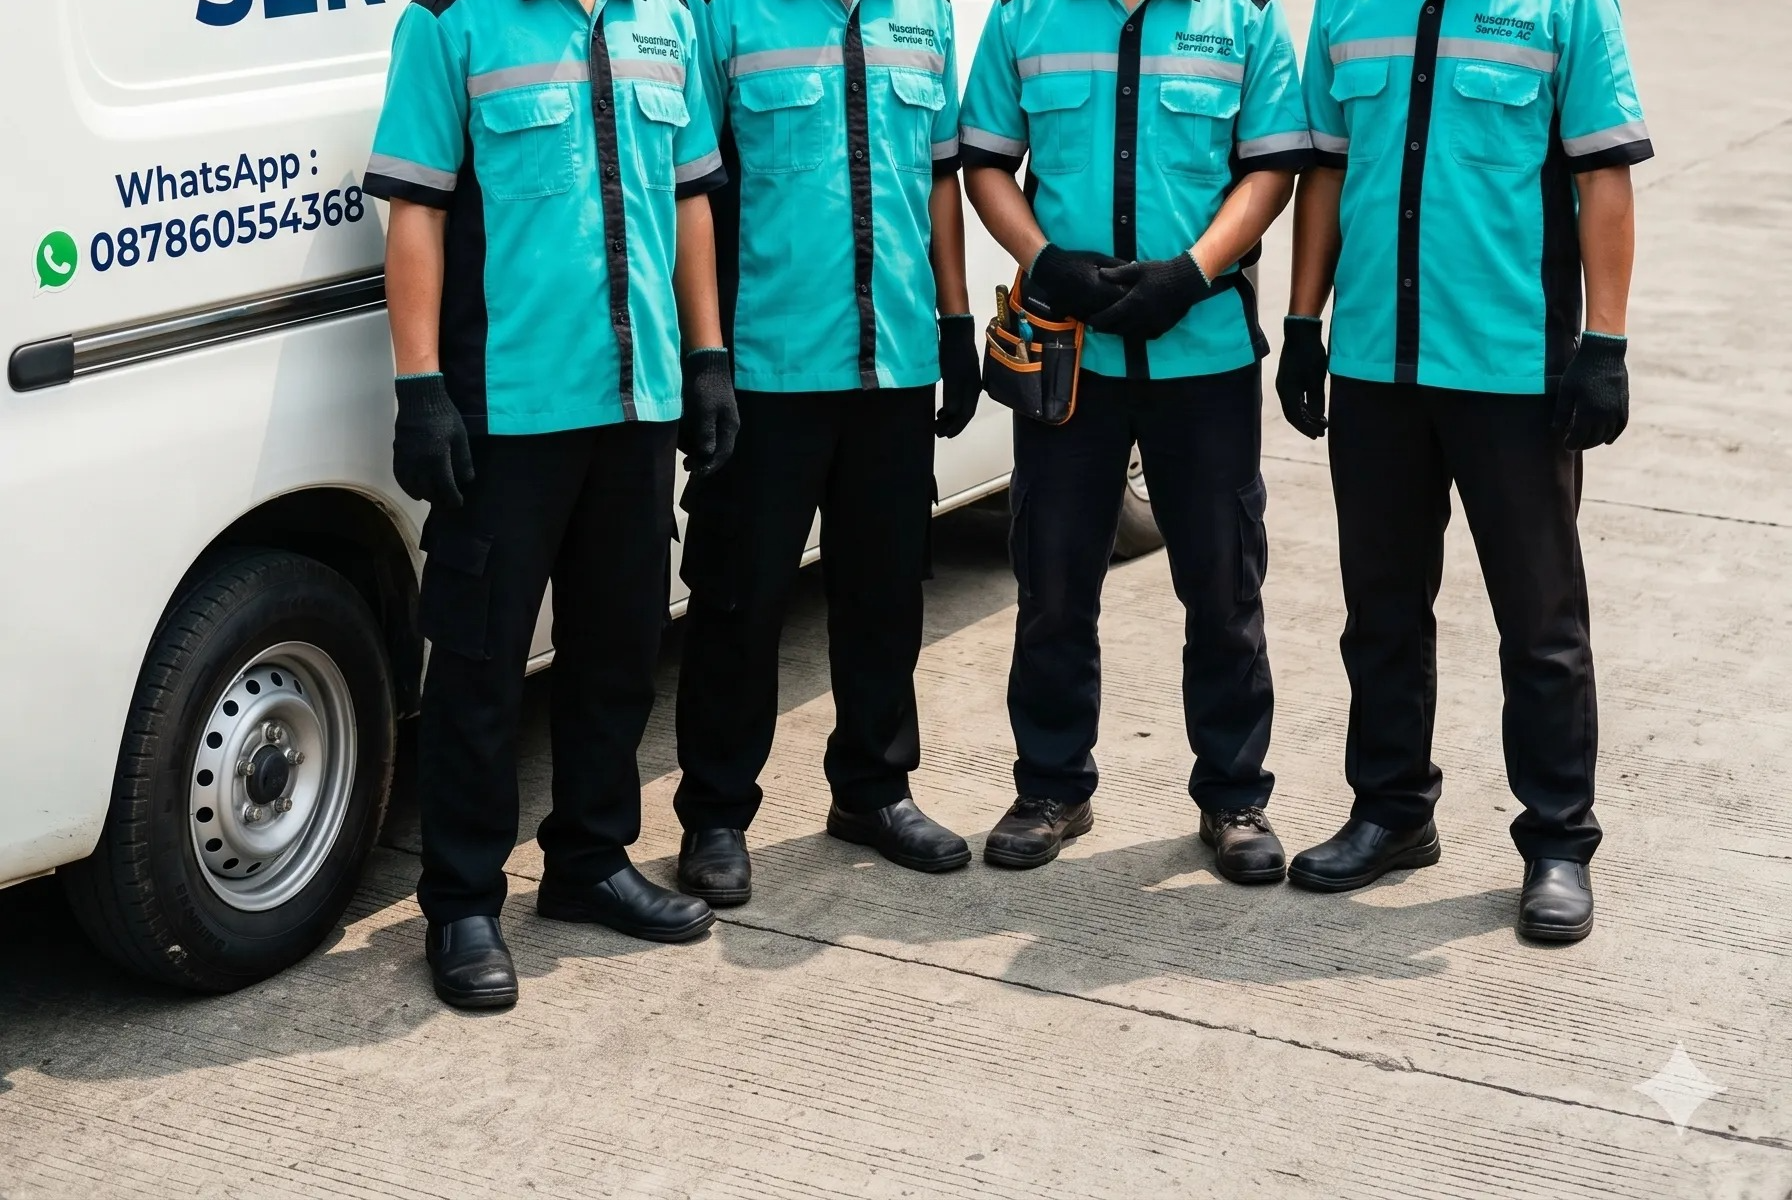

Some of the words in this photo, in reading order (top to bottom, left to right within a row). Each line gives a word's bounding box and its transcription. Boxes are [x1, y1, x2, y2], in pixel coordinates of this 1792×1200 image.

[1475, 25, 1512, 37] Service
[1515, 30, 1531, 41] AC
[1216, 47, 1231, 57] AC
[115, 152, 300, 208] WhatsApp
[90, 186, 365, 272] 087860554368
